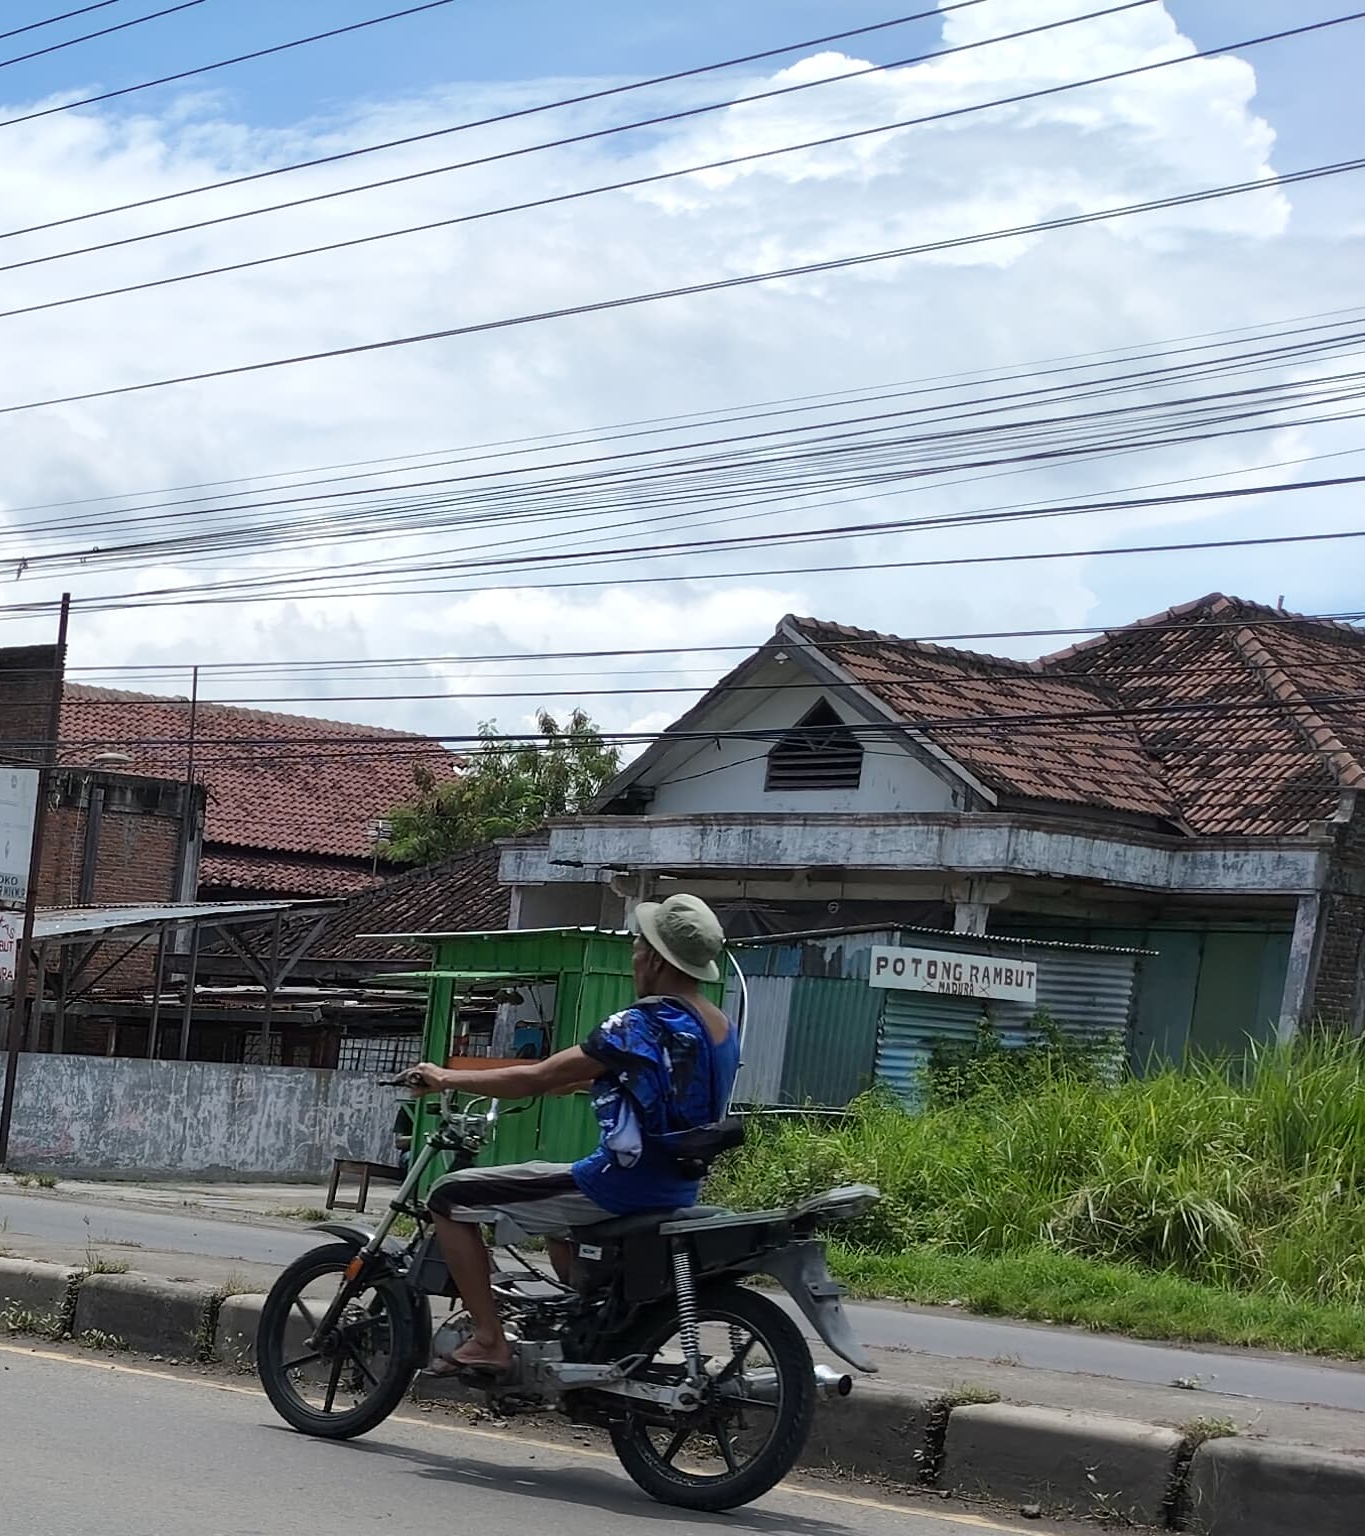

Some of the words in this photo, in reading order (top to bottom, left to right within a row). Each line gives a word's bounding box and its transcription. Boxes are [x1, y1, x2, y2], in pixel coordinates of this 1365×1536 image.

[875, 956, 963, 982] POTONG
[970, 965, 1036, 988] RAMBUT
[938, 981, 975, 996] MADURA
